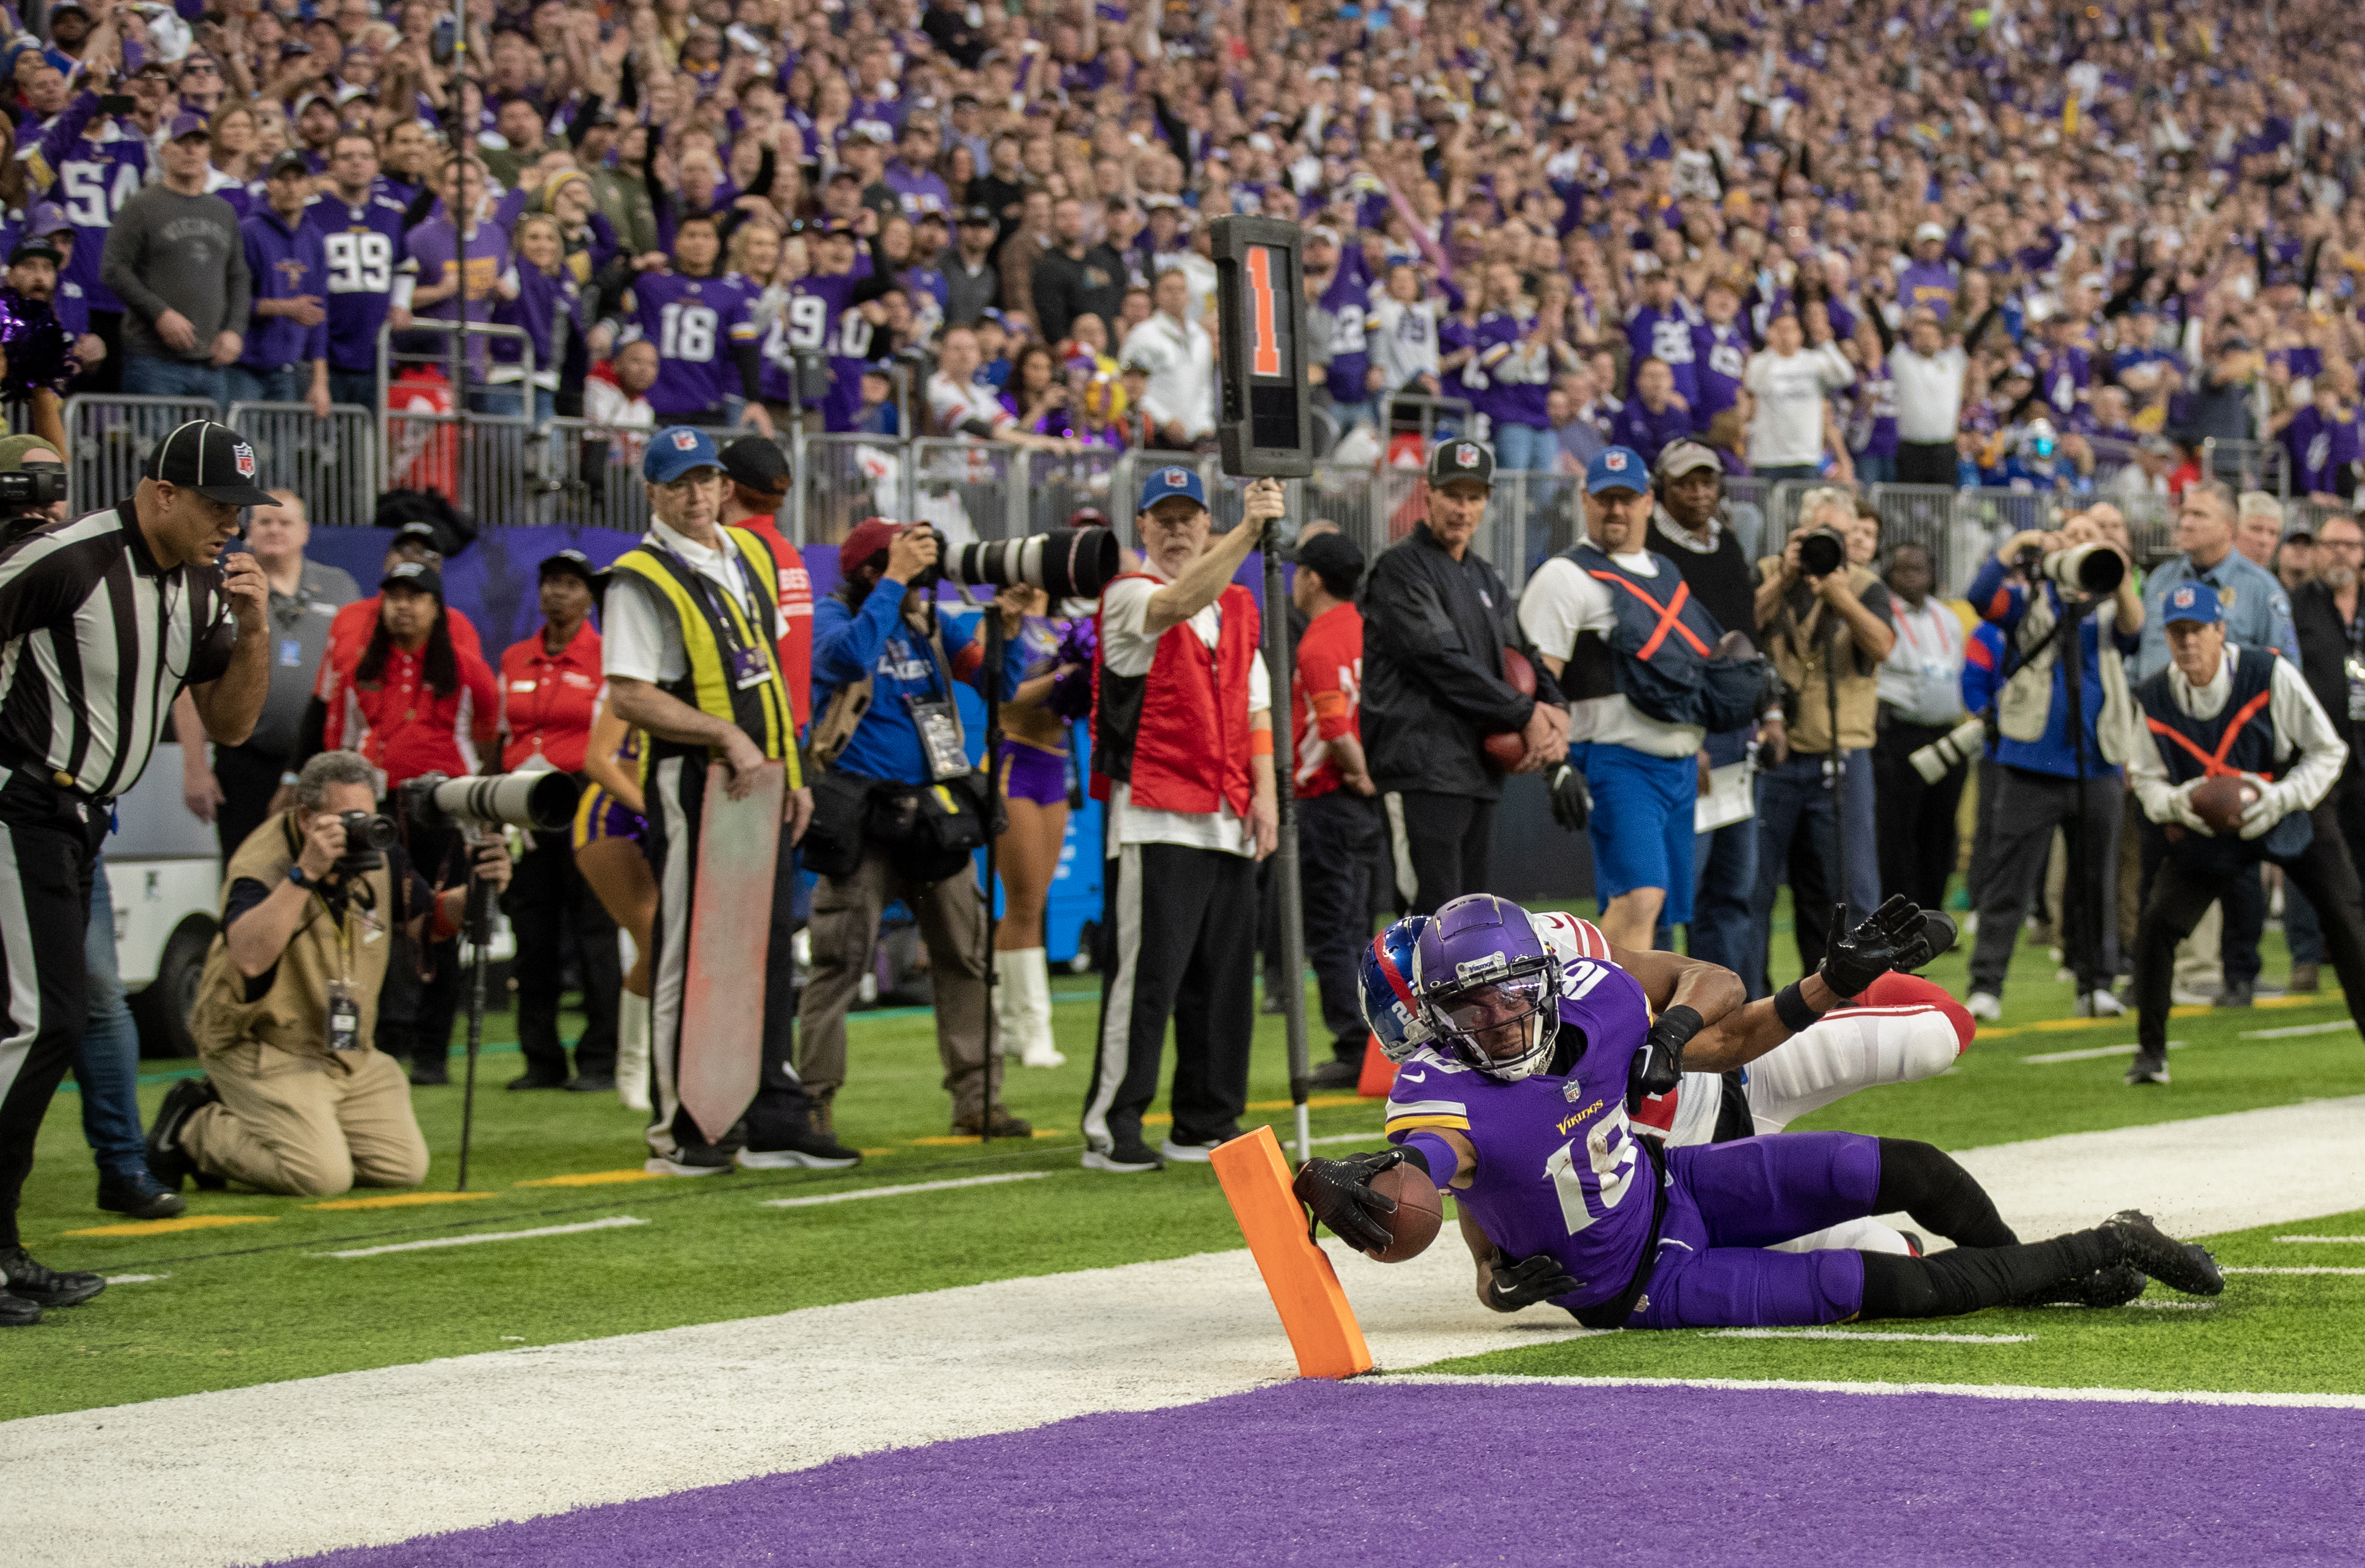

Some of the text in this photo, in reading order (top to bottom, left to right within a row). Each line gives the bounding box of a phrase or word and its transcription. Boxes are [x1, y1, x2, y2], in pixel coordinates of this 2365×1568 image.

[324, 232, 393, 293] 99
[660, 302, 719, 362] 18
[1247, 247, 1281, 377] 1
[1568, 1089, 1579, 1100] NFL
[1542, 1099, 1638, 1236] 18
